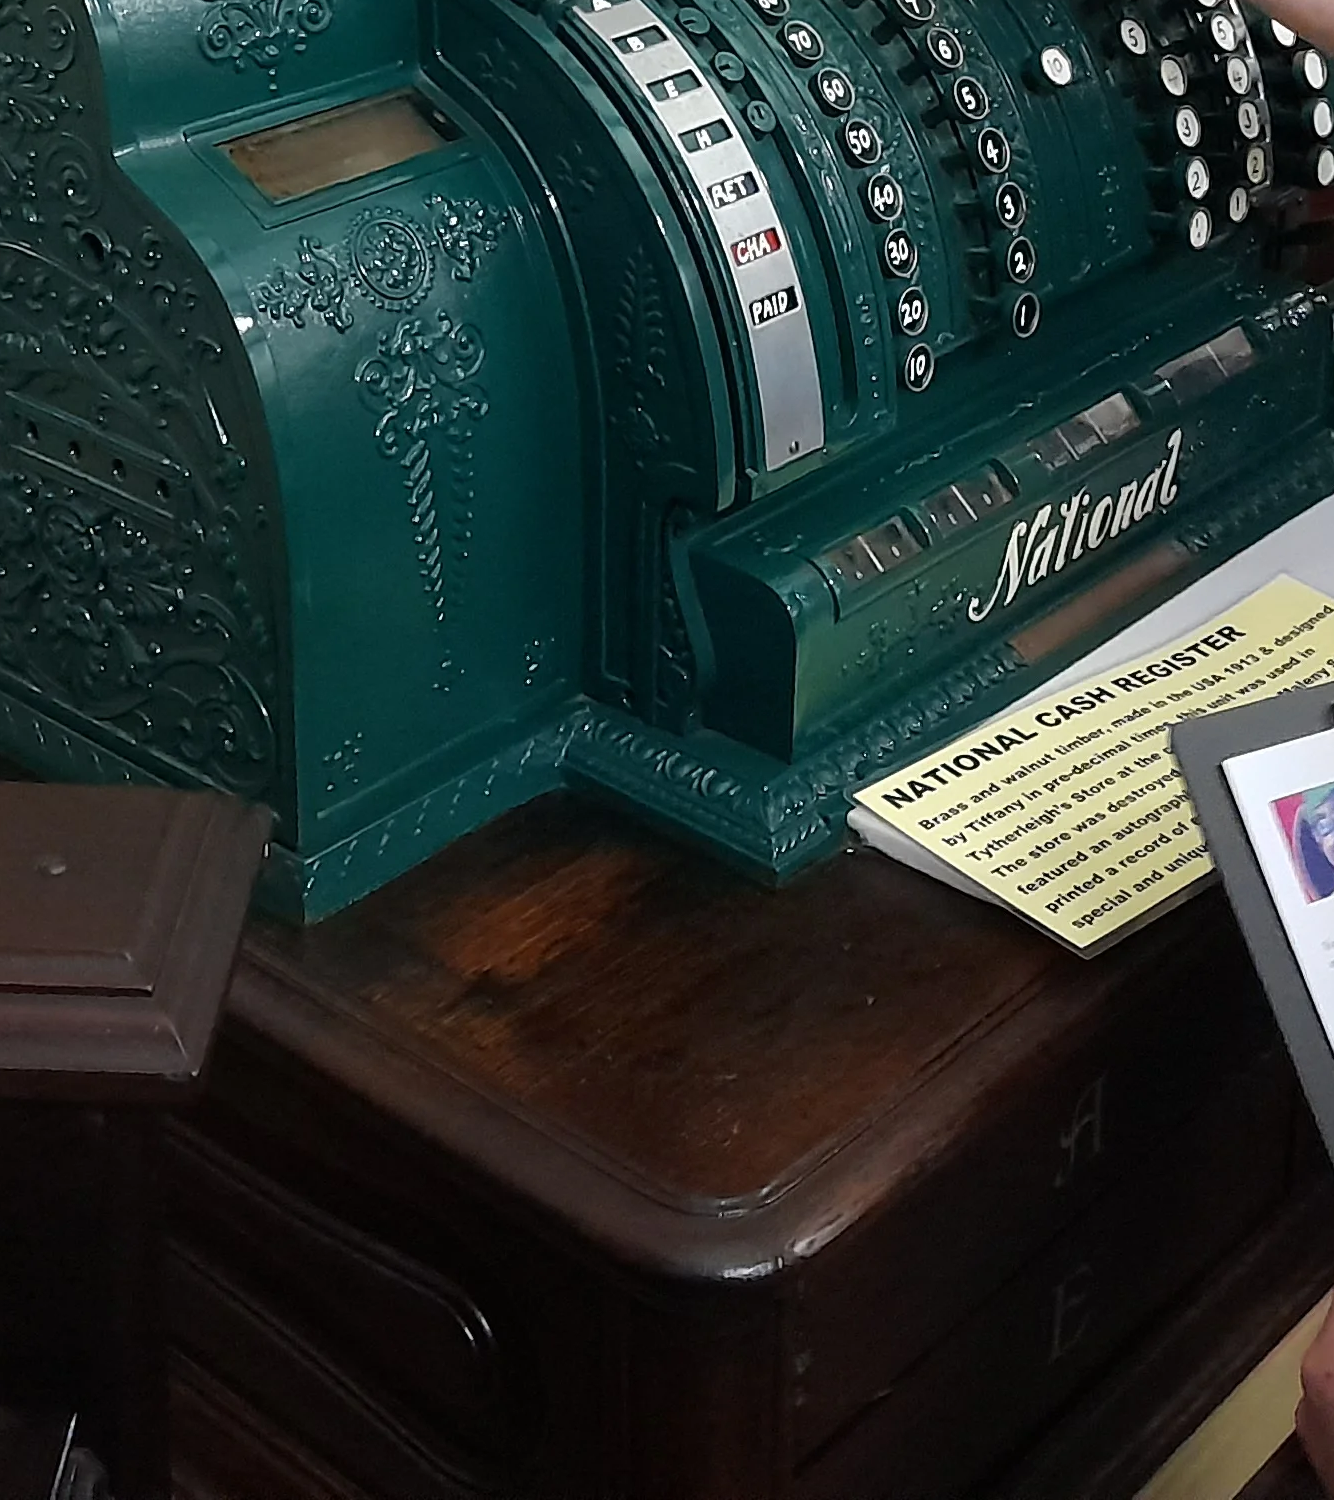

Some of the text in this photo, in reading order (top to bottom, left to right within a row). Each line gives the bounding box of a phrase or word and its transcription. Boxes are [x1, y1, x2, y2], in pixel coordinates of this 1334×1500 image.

[788, 29, 812, 52] 70
[1127, 26, 1138, 48] 5
[1216, 20, 1227, 41] 5
[627, 36, 645, 52] B
[937, 37, 951, 57] 6
[663, 78, 679, 99] E
[822, 76, 845, 100] 60
[961, 87, 976, 109] 5
[695, 129, 712, 150] H
[848, 127, 872, 153] 50
[1181, 117, 1192, 138] 3
[985, 140, 999, 164] 4
[712, 174, 747, 203] RET
[1192, 171, 1202, 192] 2
[872, 184, 901, 211] 40
[1003, 193, 1015, 218] 3
[735, 233, 772, 265] CHA
[888, 238, 910, 265] 30
[1014, 251, 1026, 273] 2
[752, 291, 789, 326] PAID
[900, 298, 923, 324] 20
[1020, 304, 1027, 326] 1
[909, 355, 928, 381] 10
[967, 427, 1183, 622] National
[881, 623, 1247, 810] NATIONAL CASH REGISTER
[918, 803, 968, 831] Brass
[969, 782, 1002, 804] and
[1000, 752, 1057, 785] walnut
[1054, 726, 1113, 758] timber,
[1111, 706, 1152, 729] made
[1153, 698, 1169, 710] in
[1166, 687, 1193, 706] the
[1191, 673, 1227, 692] USA
[1223, 653, 1261, 676] 1913
[1258, 646, 1275, 657] &
[942, 831, 968, 849] by
[964, 799, 1026, 835] Tiffany
[1024, 788, 1043, 802] in
[1043, 740, 1132, 794] pre-decimal
[1208, 691, 1238, 710] unit
[1234, 677, 1267, 696] was
[1265, 655, 1301, 680] used
[1300, 646, 1317, 660] in
[964, 751, 1162, 864] Tytherleigh's Store at the
[990, 767, 1183, 879] The store was destroyed
[1017, 850, 1090, 897] featured
[1088, 837, 1114, 855] an
[1044, 819, 1191, 914] printed a record of
[1071, 889, 1133, 929] special
[1131, 870, 1166, 893] and
